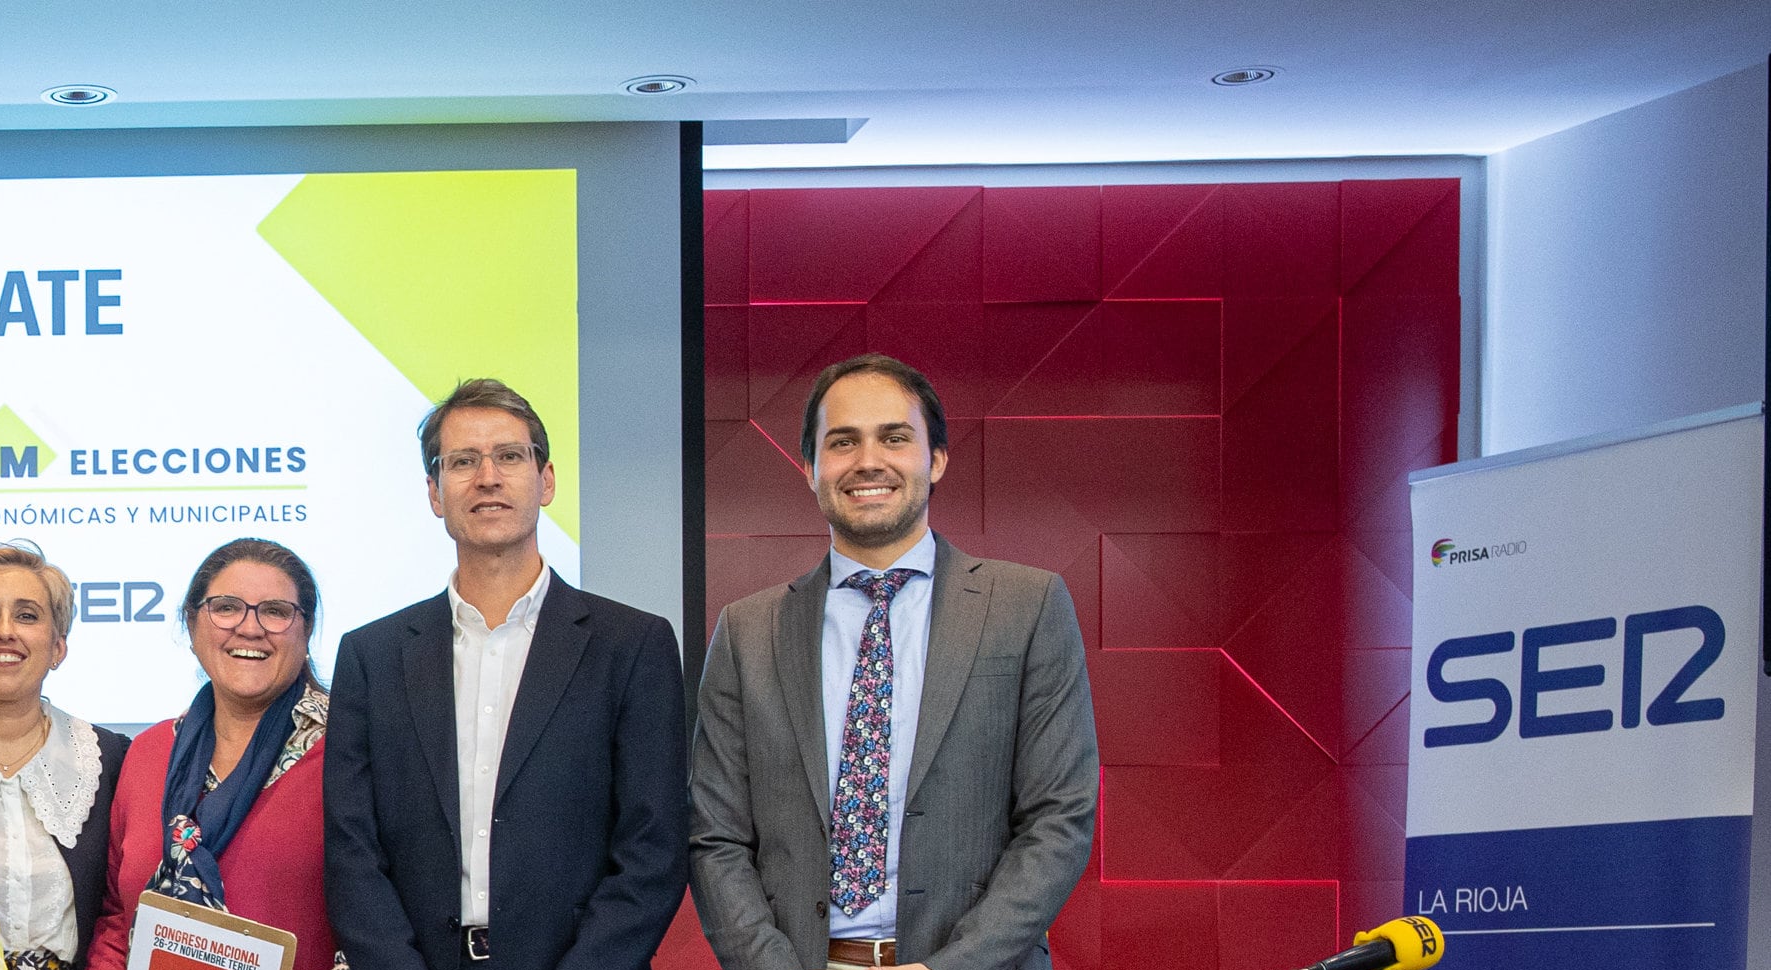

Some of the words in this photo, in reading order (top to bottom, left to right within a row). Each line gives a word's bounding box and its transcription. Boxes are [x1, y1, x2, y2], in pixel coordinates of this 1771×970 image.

[70, 446, 307, 476] ELECCIONES
[127, 506, 140, 524] Y
[149, 504, 308, 524] MUNICIPALES
[1449, 545, 1490, 565] PRISA
[73, 581, 166, 623] ER
[1424, 604, 1726, 748] SER
[1418, 889, 1448, 914] LA
[1455, 886, 1528, 913] RIOJA
[153, 936, 179, 952] 26-27
[179, 944, 227, 967] NOVIEMBRE
[154, 923, 208, 950] CONGRESO
[210, 940, 261, 967] NACIONAL
